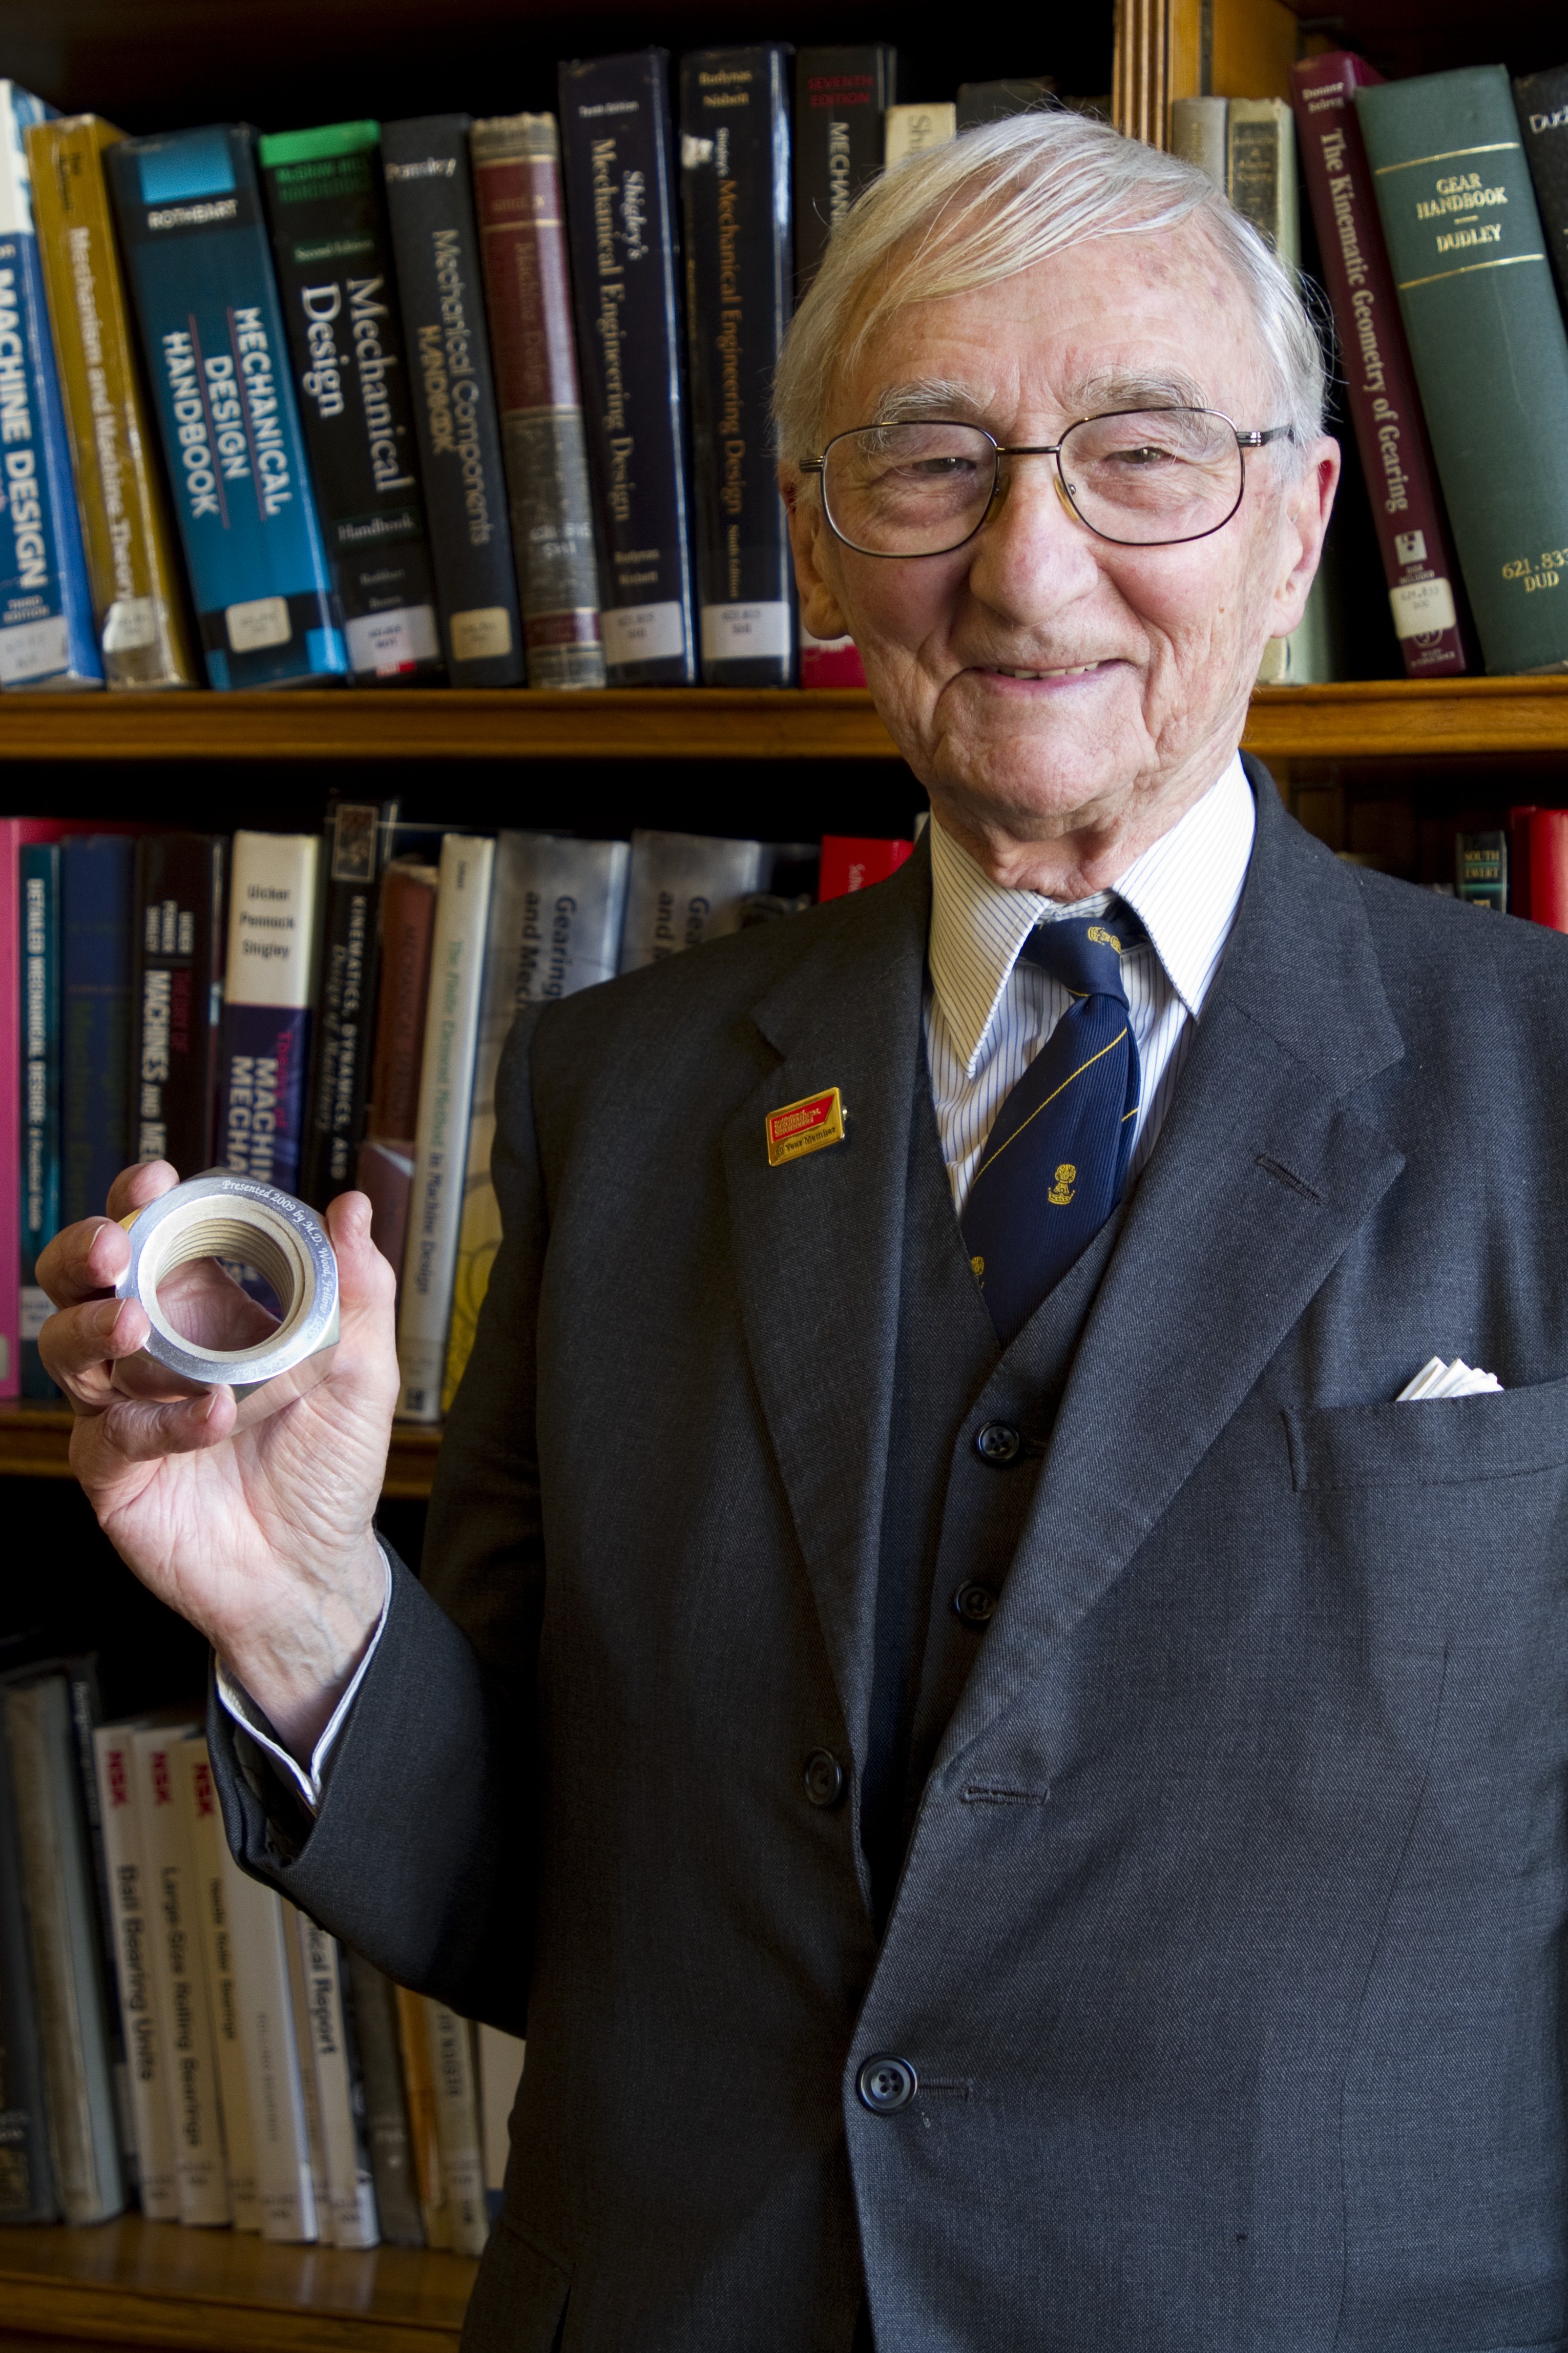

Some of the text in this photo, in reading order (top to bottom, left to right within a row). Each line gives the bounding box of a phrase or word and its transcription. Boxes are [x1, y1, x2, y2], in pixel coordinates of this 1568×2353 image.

[810, 92, 870, 107] EDITION
[716, 127, 730, 178] Shigley's
[149, 199, 238, 230] ROTHBART
[620, 170, 649, 260] Shigley's
[1416, 187, 1509, 220] HANDBOOK
[1436, 173, 1482, 196] GEAR
[1436, 223, 1502, 254] DUDLEY
[301, 282, 345, 419] Design
[591, 138, 635, 522] Mechanical Engineering Design
[717, 179, 747, 517] Mechanical Engineering Design
[1320, 128, 1410, 514] The Kinematic Geometry of Gearing
[69, 227, 135, 600] Mechanism and Machine Theory
[234, 307, 293, 515] MECHANICAL
[346, 275, 416, 493] Mechanical
[417, 325, 457, 457] HANDBOOK
[432, 230, 495, 546] Mechanical Components
[162, 331, 220, 519] HANDBOOK
[205, 356, 250, 481] DESIGN
[5, 449, 49, 590] DESIGN
[338, 513, 415, 543] Handbook
[726, 524, 741, 598] Ninth Edition
[1523, 570, 1560, 593] DUD
[27, 878, 46, 954] DETAILED
[521, 891, 541, 939] and
[541, 895, 577, 997] Gearing
[655, 891, 675, 940] and
[27, 956, 47, 1058] MECHANICAL
[142, 970, 172, 1083] MACHINES
[435, 1020, 456, 1084] Element
[140, 1083, 161, 1119] AND
[330, 1135, 349, 1180] AND
[774, 1126, 837, 1156] 50 Year Member
[222, 1179, 277, 1200] Presented
[270, 1193, 297, 1212] 2009
[293, 1209, 306, 1223] by
[421, 1173, 444, 1236] Machine
[300, 1221, 324, 1246] M.D.
[318, 1247, 332, 1277] Wood,
[319, 1279, 333, 1314] Fellow
[413, 1241, 436, 1295] Design
[106, 1749, 131, 1808] NSK
[148, 1749, 173, 1807] NSK
[192, 1762, 216, 1819] NSK
[116, 1864, 154, 2082] Ball Bearing Units
[172, 1980, 192, 2051] Rolling
[220, 1978, 236, 2041] Bearings
[308, 1977, 337, 2055] Report
[180, 2057, 200, 2148] Bearings
